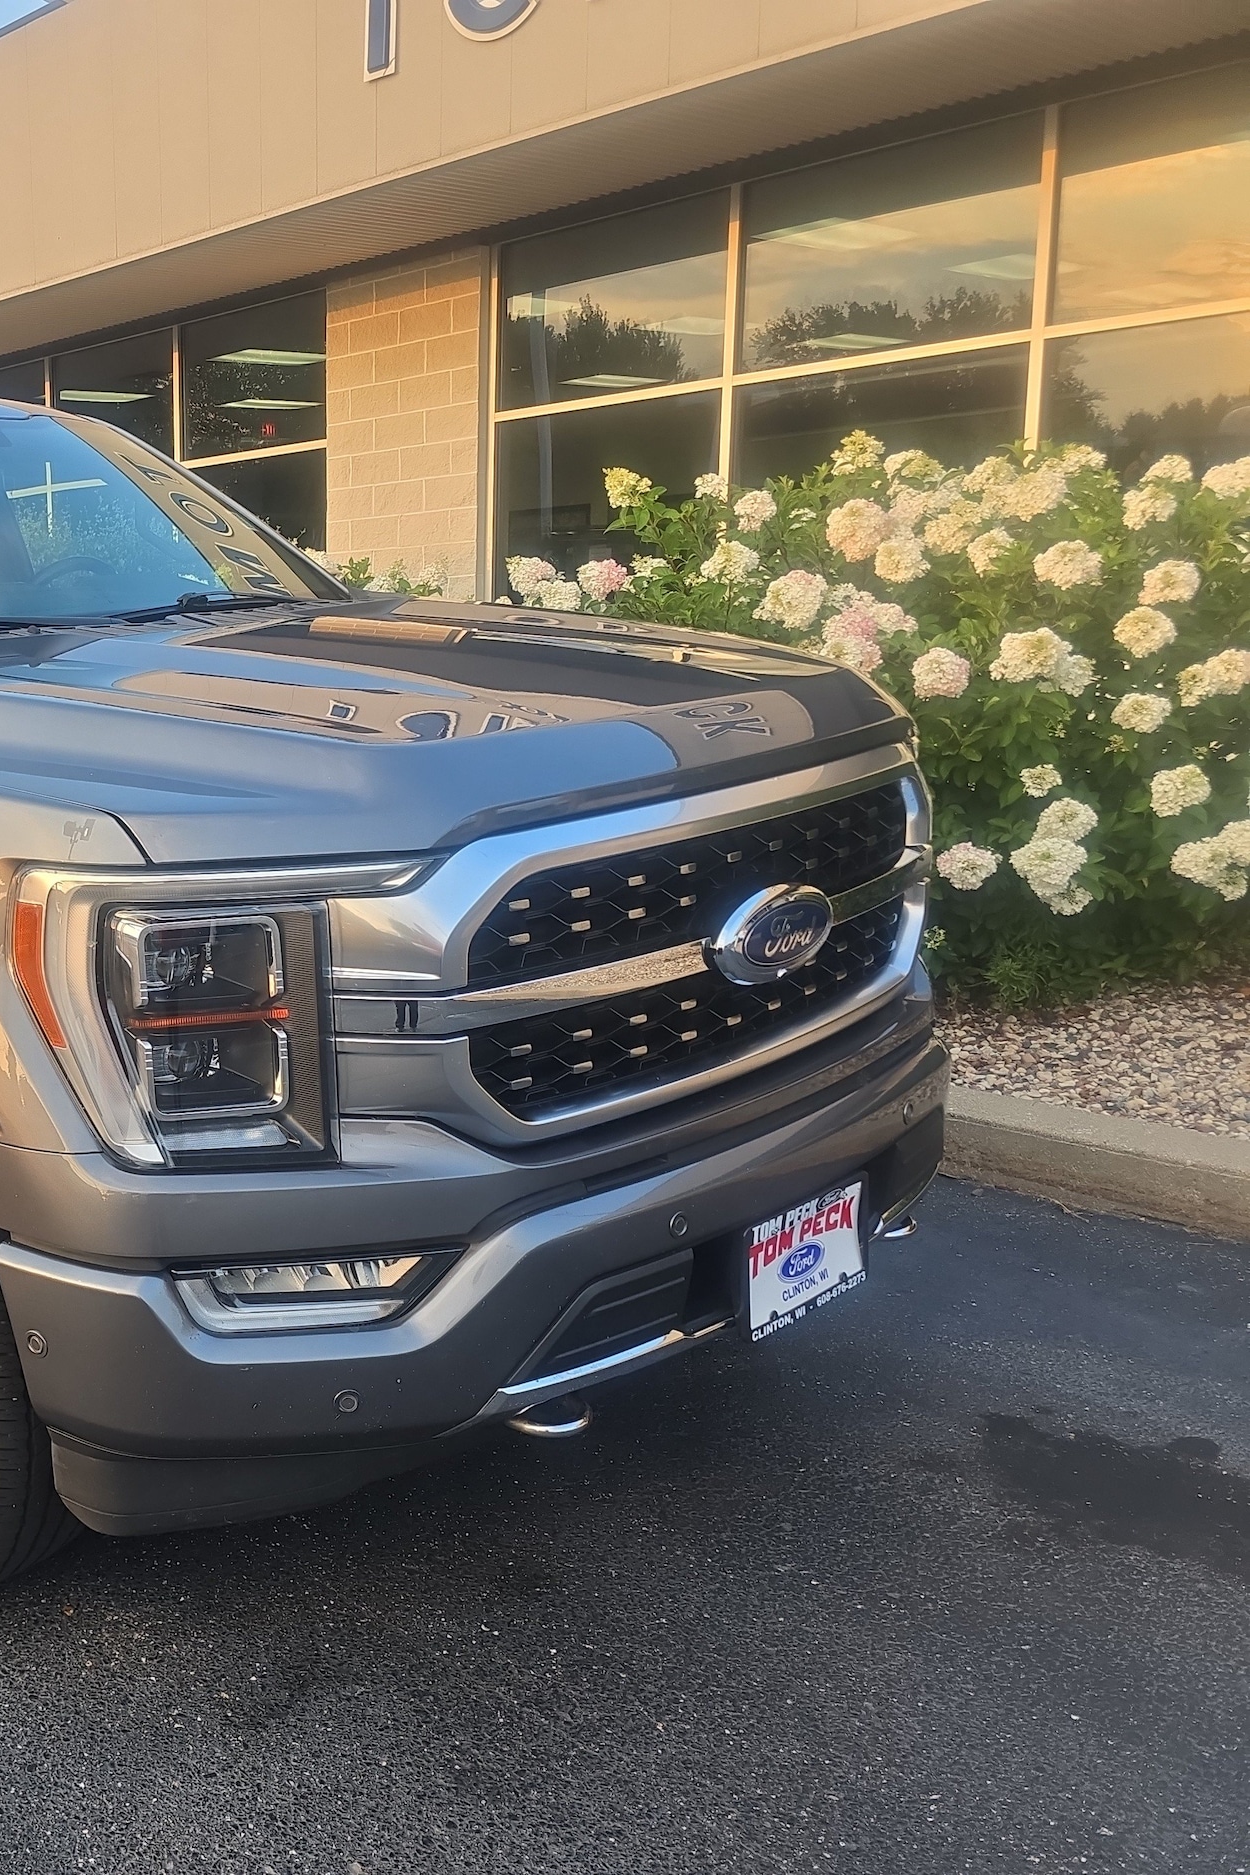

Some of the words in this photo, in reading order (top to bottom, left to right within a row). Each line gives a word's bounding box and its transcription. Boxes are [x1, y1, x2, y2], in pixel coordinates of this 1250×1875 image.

[748, 1226, 795, 1280] TOM
[799, 1195, 856, 1243] PECK
[752, 1214, 783, 1244] TOM
[784, 1197, 820, 1229] PECK
[787, 1248, 815, 1276] Ford
[782, 1275, 819, 1302] CLINTON,
[818, 1267, 830, 1282] WI
[751, 1312, 794, 1342] CLINTON,
[794, 1304, 807, 1320] WI
